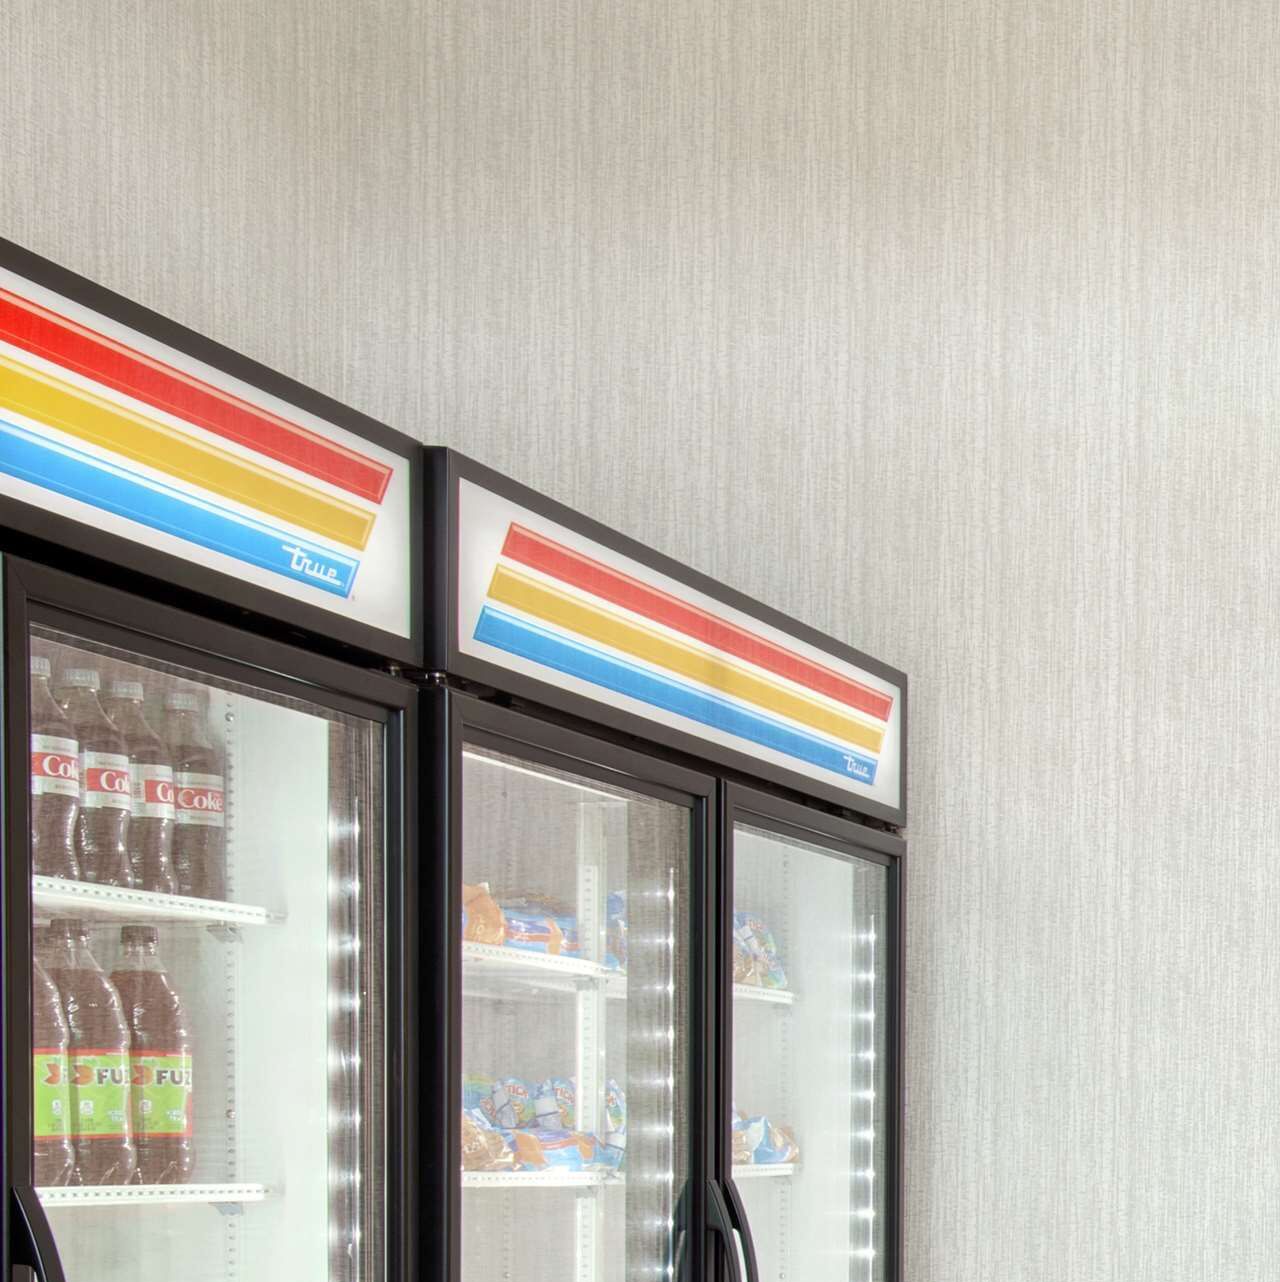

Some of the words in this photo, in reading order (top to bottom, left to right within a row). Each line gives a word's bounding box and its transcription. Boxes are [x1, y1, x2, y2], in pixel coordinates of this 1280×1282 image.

[281, 545, 343, 587] true
[43, 755, 79, 781] Cok
[157, 782, 174, 803] Co
[177, 788, 223, 812] Coke
